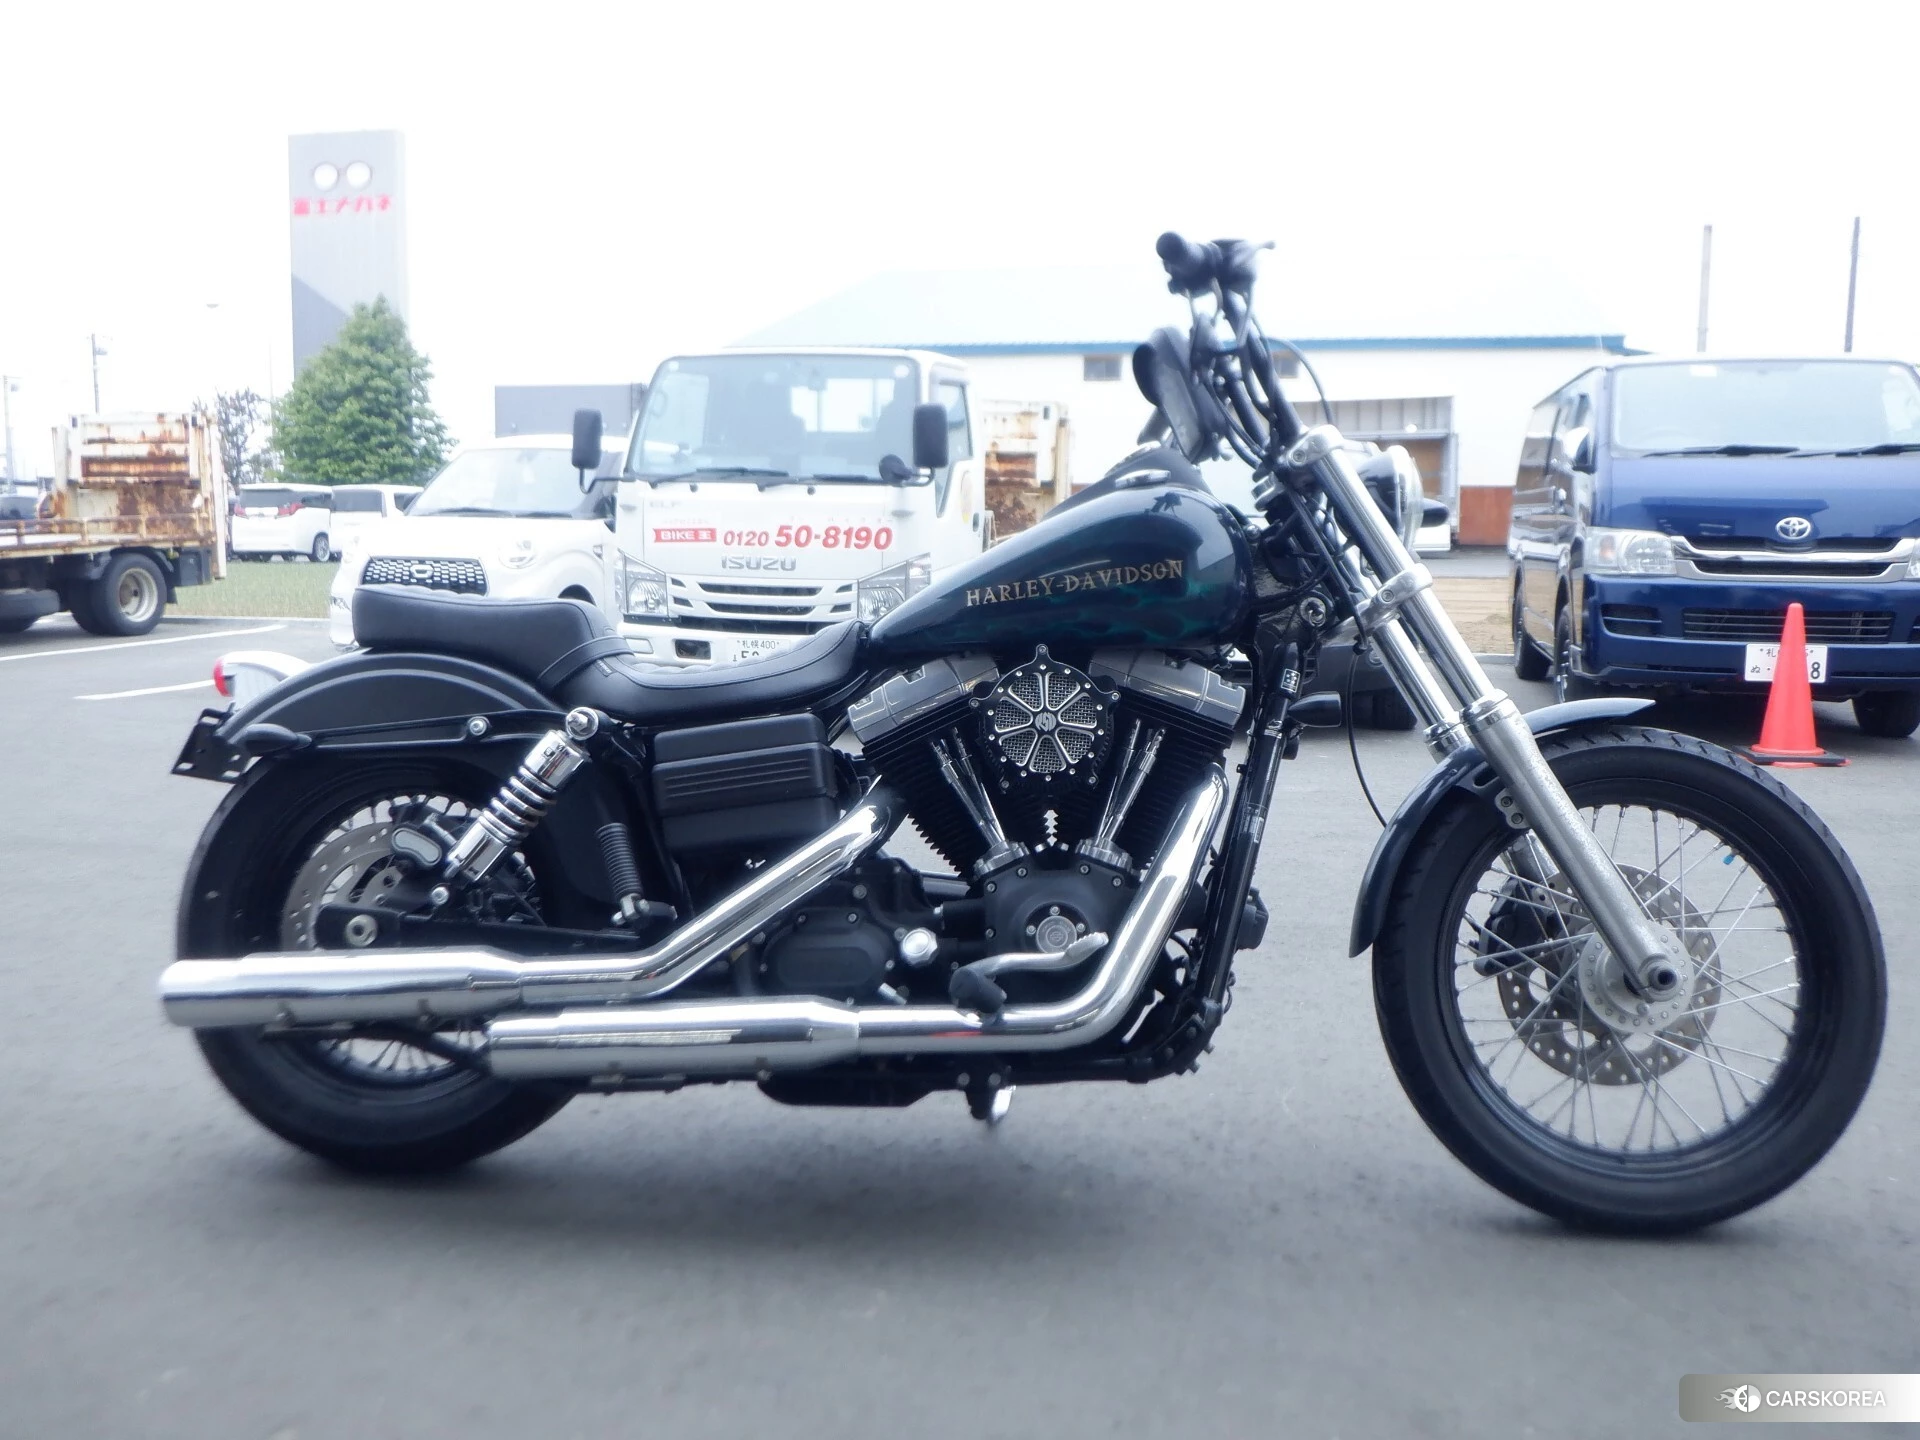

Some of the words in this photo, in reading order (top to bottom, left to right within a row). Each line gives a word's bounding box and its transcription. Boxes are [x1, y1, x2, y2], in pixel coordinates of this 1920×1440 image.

[660, 530, 695, 541] BIKE
[723, 530, 770, 547] 0120
[774, 524, 893, 550] 50-8190
[721, 555, 797, 572] ISUZU
[966, 559, 1184, 607] HARLEY-DAVIDSON
